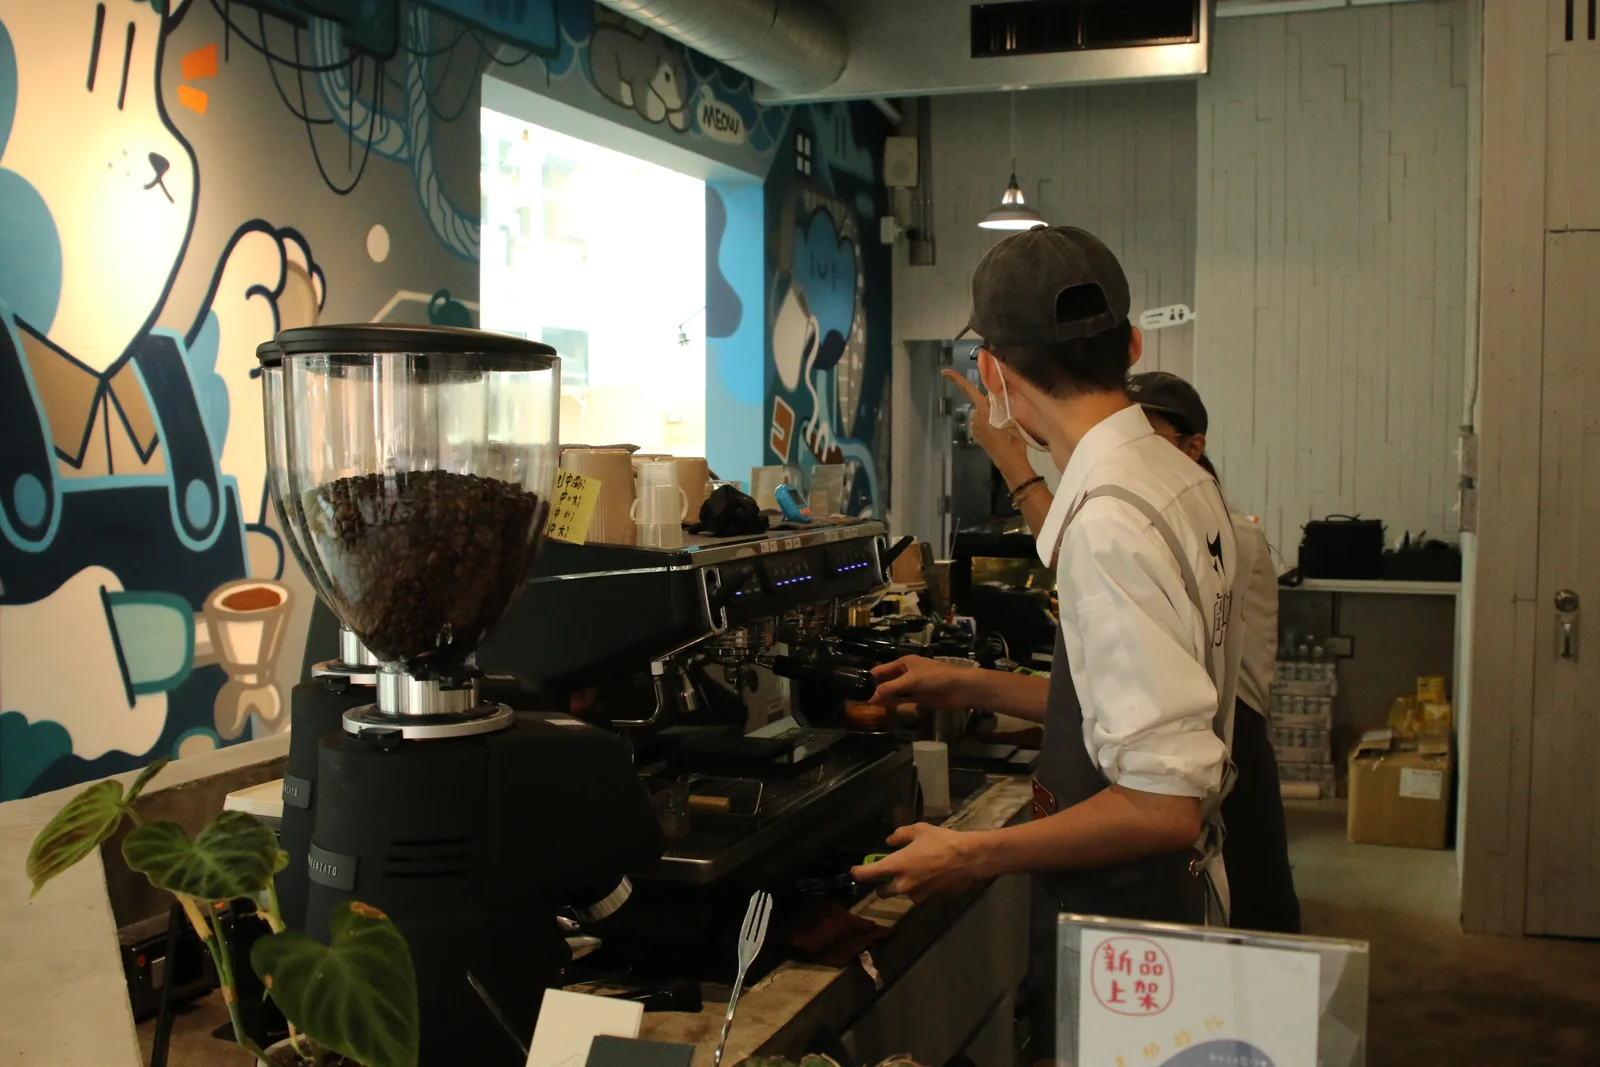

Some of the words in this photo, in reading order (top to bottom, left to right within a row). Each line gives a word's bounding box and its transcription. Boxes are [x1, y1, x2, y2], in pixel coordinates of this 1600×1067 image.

[702, 105, 740, 135] MEOW
[1102, 943, 1164, 976] 新品
[1107, 979, 1160, 1011] 上架
